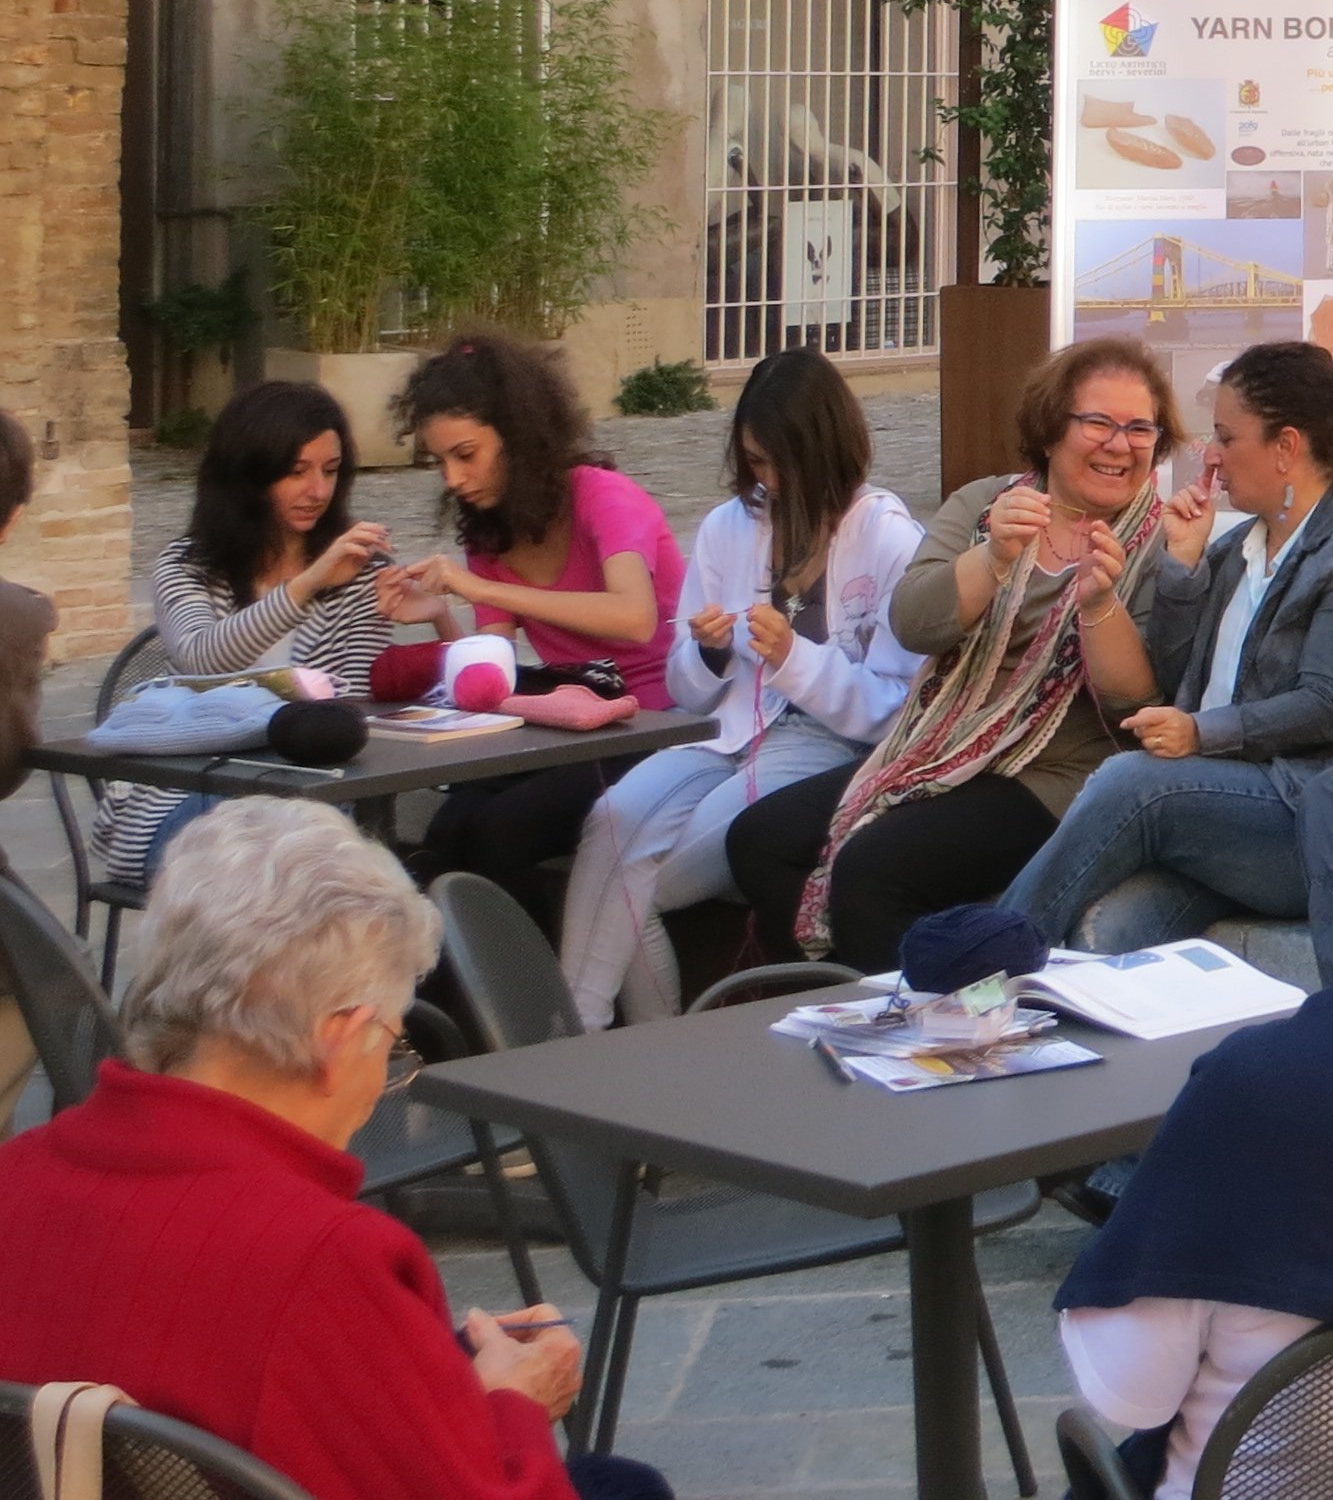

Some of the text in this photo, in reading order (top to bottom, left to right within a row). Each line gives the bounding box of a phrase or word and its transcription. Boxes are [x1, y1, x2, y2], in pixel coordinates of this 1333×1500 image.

[1191, 16, 1272, 40] YARN
[1306, 67, 1325, 77] Più
[1281, 128, 1301, 136] Dalle
[1303, 127, 1325, 138] fragili
[1307, 148, 1323, 156] nata
[1319, 158, 1332, 167] che
